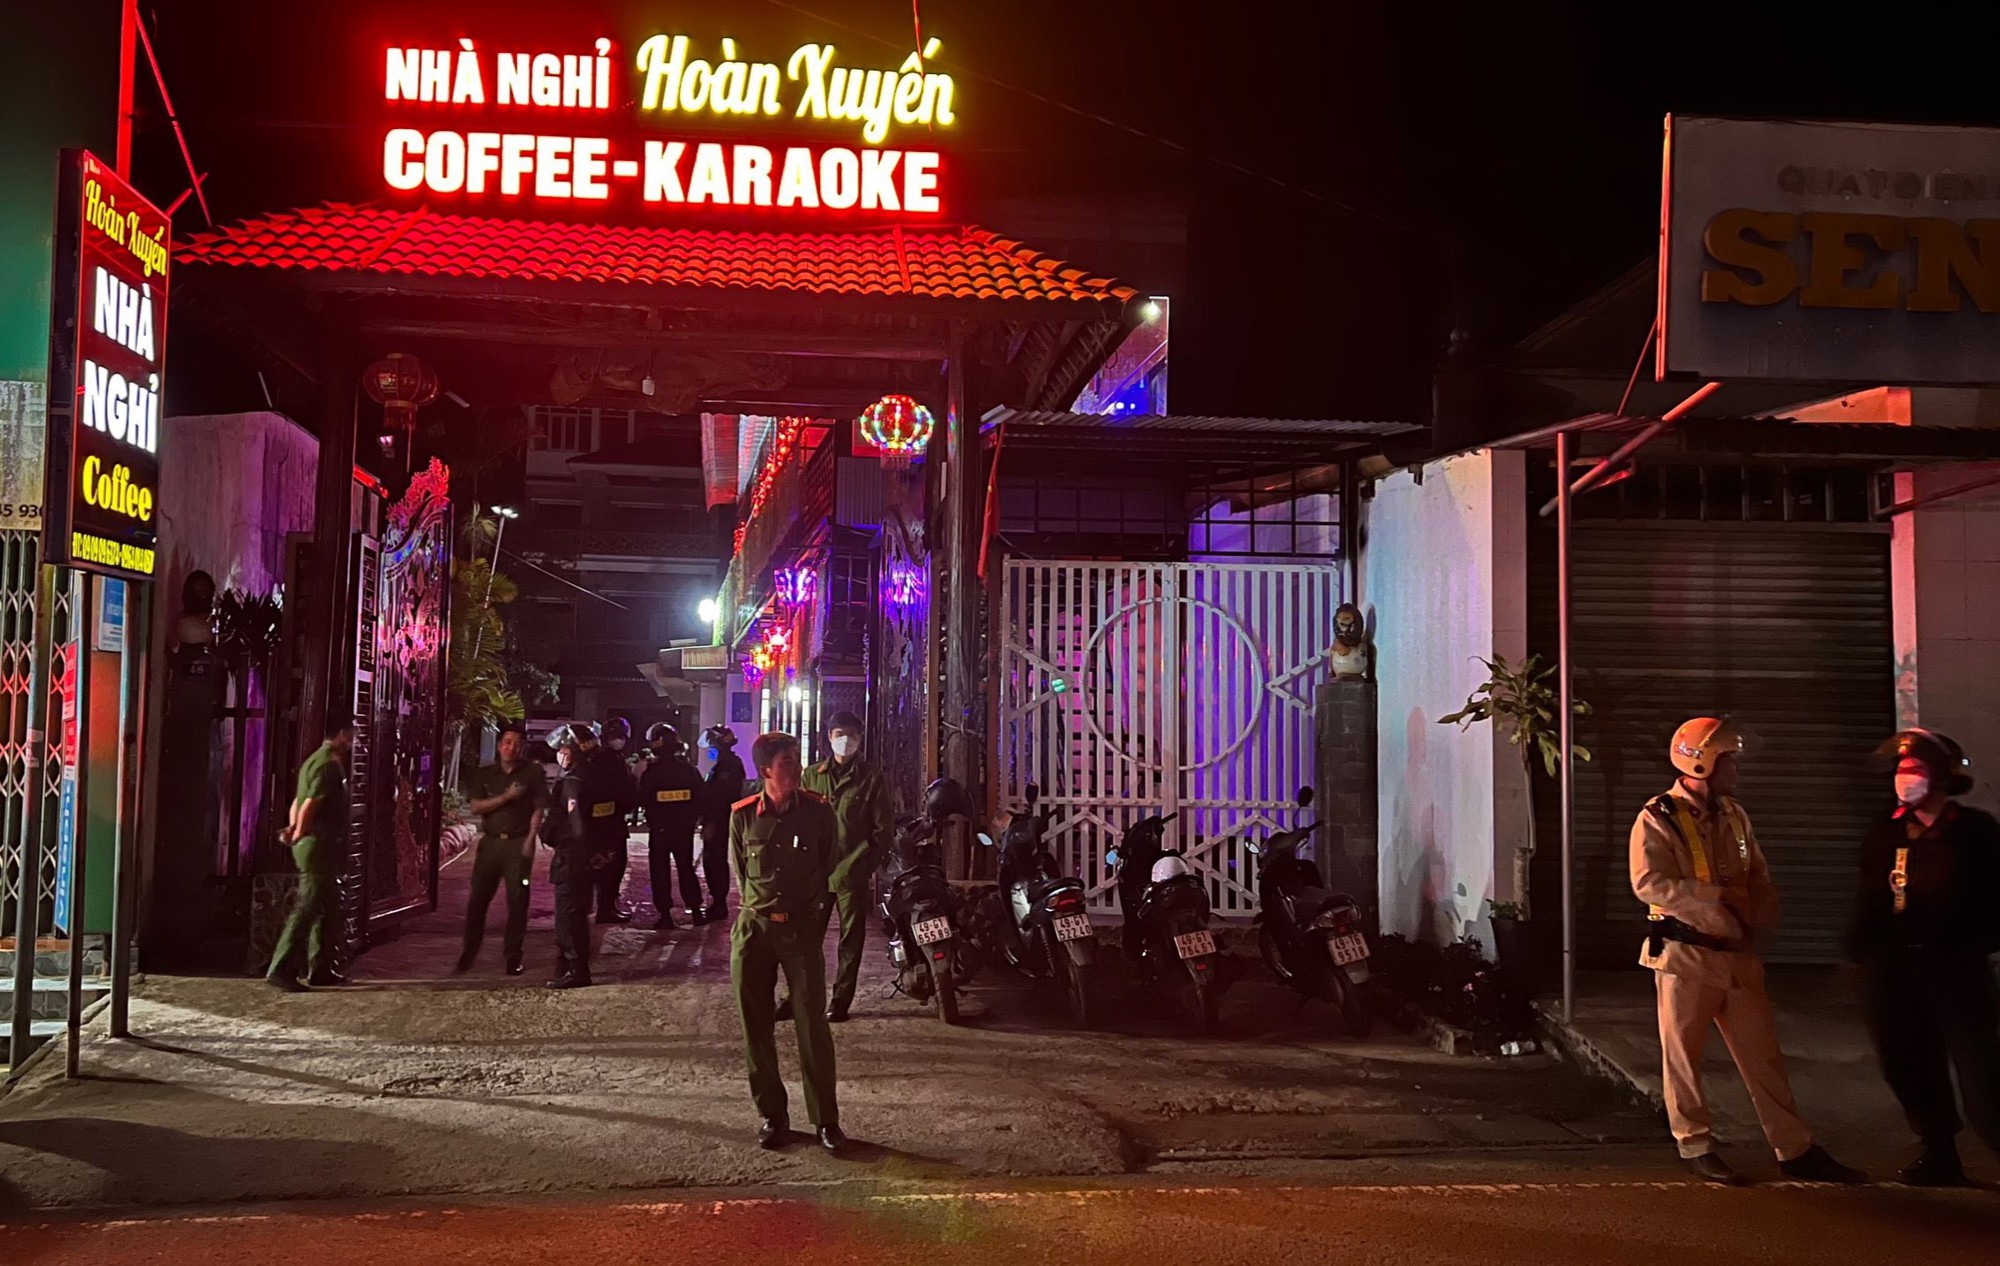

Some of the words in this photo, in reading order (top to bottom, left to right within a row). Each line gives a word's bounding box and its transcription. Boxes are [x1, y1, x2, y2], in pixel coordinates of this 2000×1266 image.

[385, 38, 485, 105] NHÀ
[497, 36, 611, 109] NGHỈ
[636, 33, 781, 117] Hoàn
[787, 37, 955, 144] Xuyến
[86, 179, 125, 246] Hoàn
[126, 211, 167, 278] Xuyến
[1702, 207, 2000, 314] SEN
[94, 265, 155, 362] NHÀ
[82, 359, 159, 454] NGHỈ
[0, 504, 13, 518] 5
[82, 455, 153, 522] Coffee
